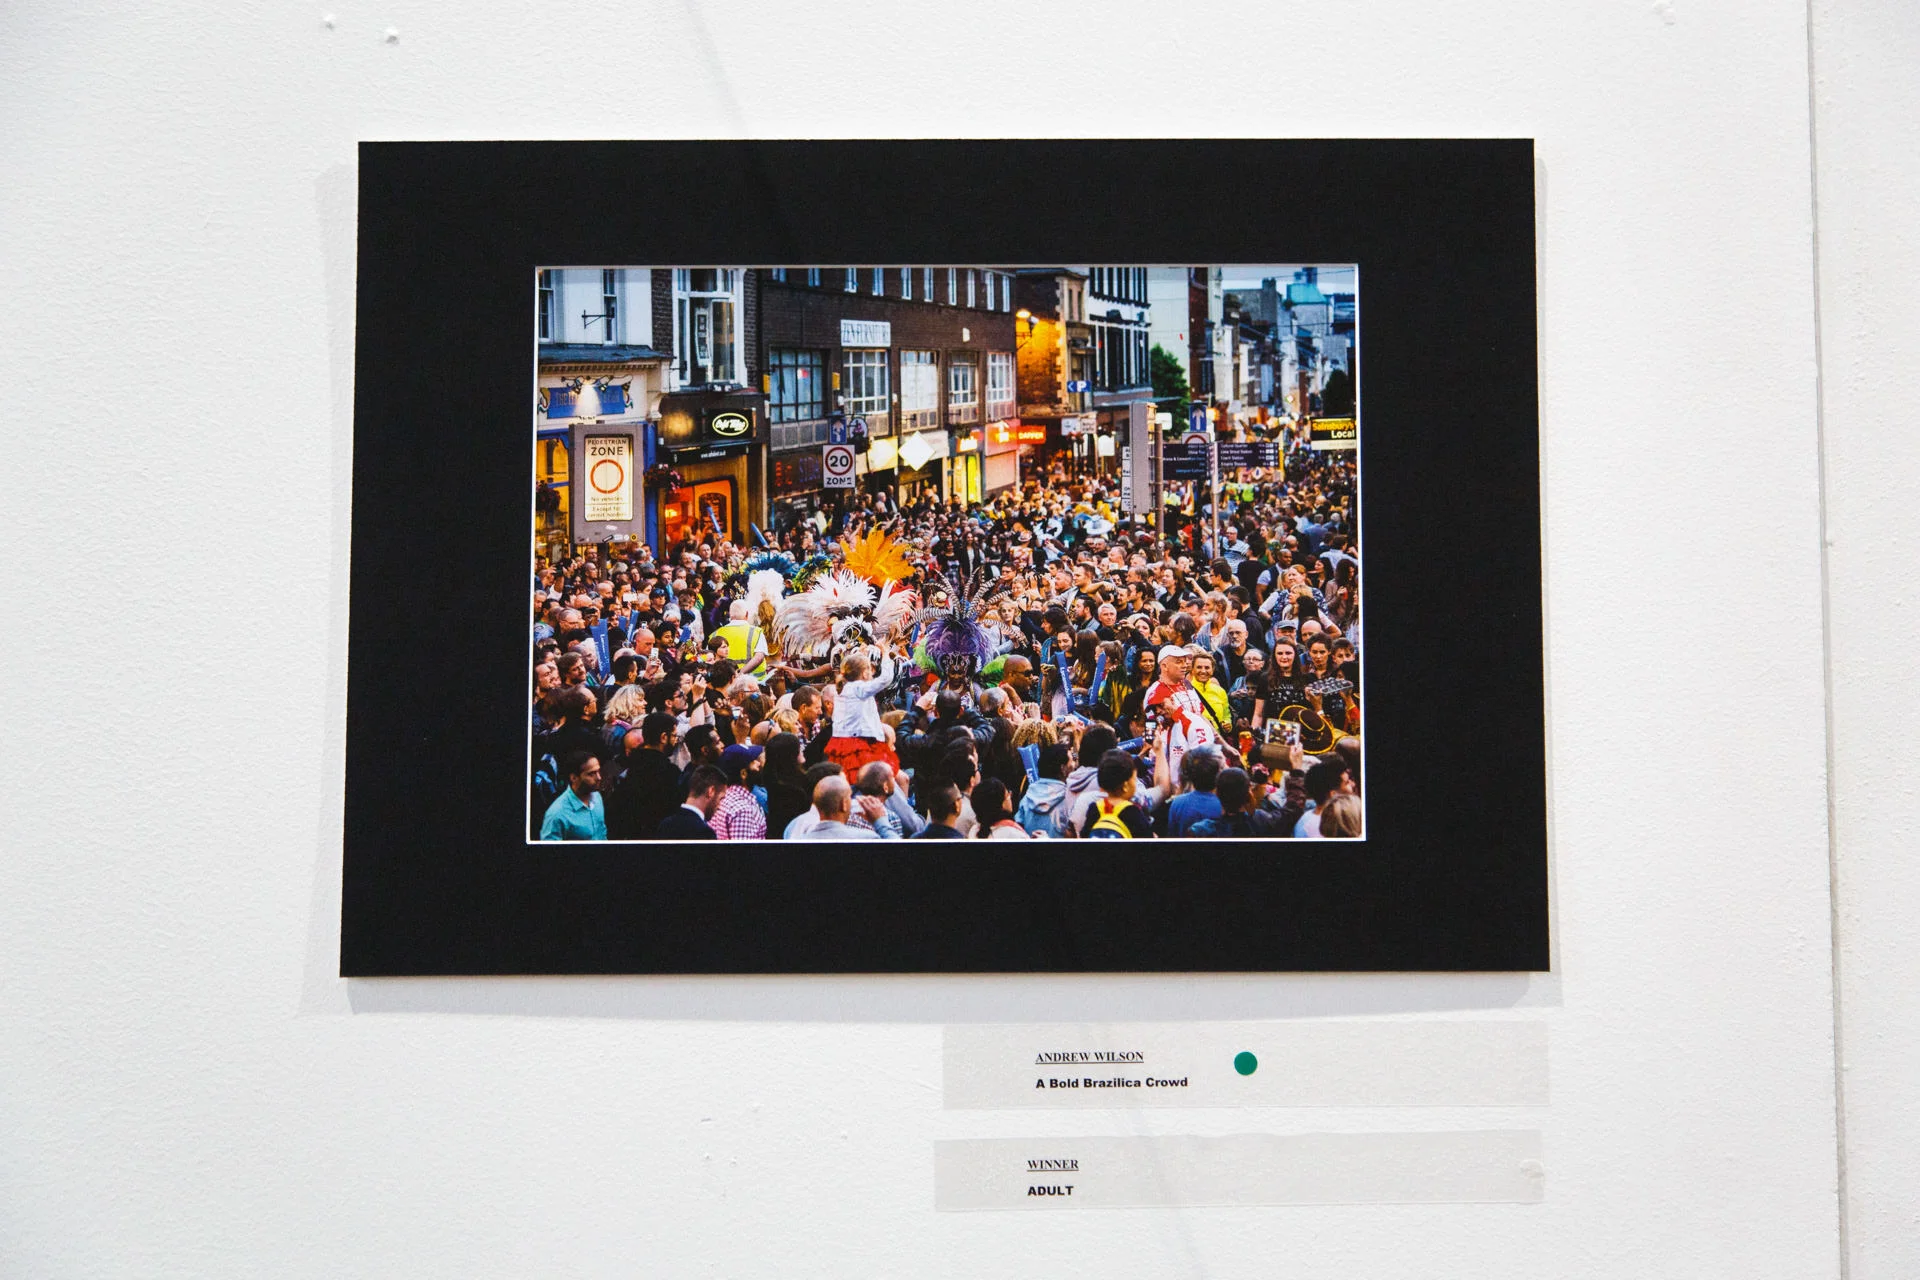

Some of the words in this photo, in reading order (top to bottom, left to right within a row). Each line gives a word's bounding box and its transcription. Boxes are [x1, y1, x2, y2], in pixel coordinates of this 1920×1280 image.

[1080, 381, 1086, 391] P
[1312, 421, 1355, 431] Sainsbury's
[1331, 430, 1355, 439] Local
[590, 446, 624, 456] ZONE
[829, 455, 849, 467] 20
[826, 477, 852, 485] ZONE
[1035, 1052, 1091, 1063] ANDREW
[1095, 1051, 1144, 1062] WILSON
[1035, 1078, 1046, 1089] A
[1049, 1078, 1079, 1089] Bold
[1083, 1077, 1141, 1088] Brazilica
[1145, 1077, 1189, 1088] Crowd
[1027, 1159, 1079, 1170] WINNER
[1027, 1185, 1074, 1196] ADULT
